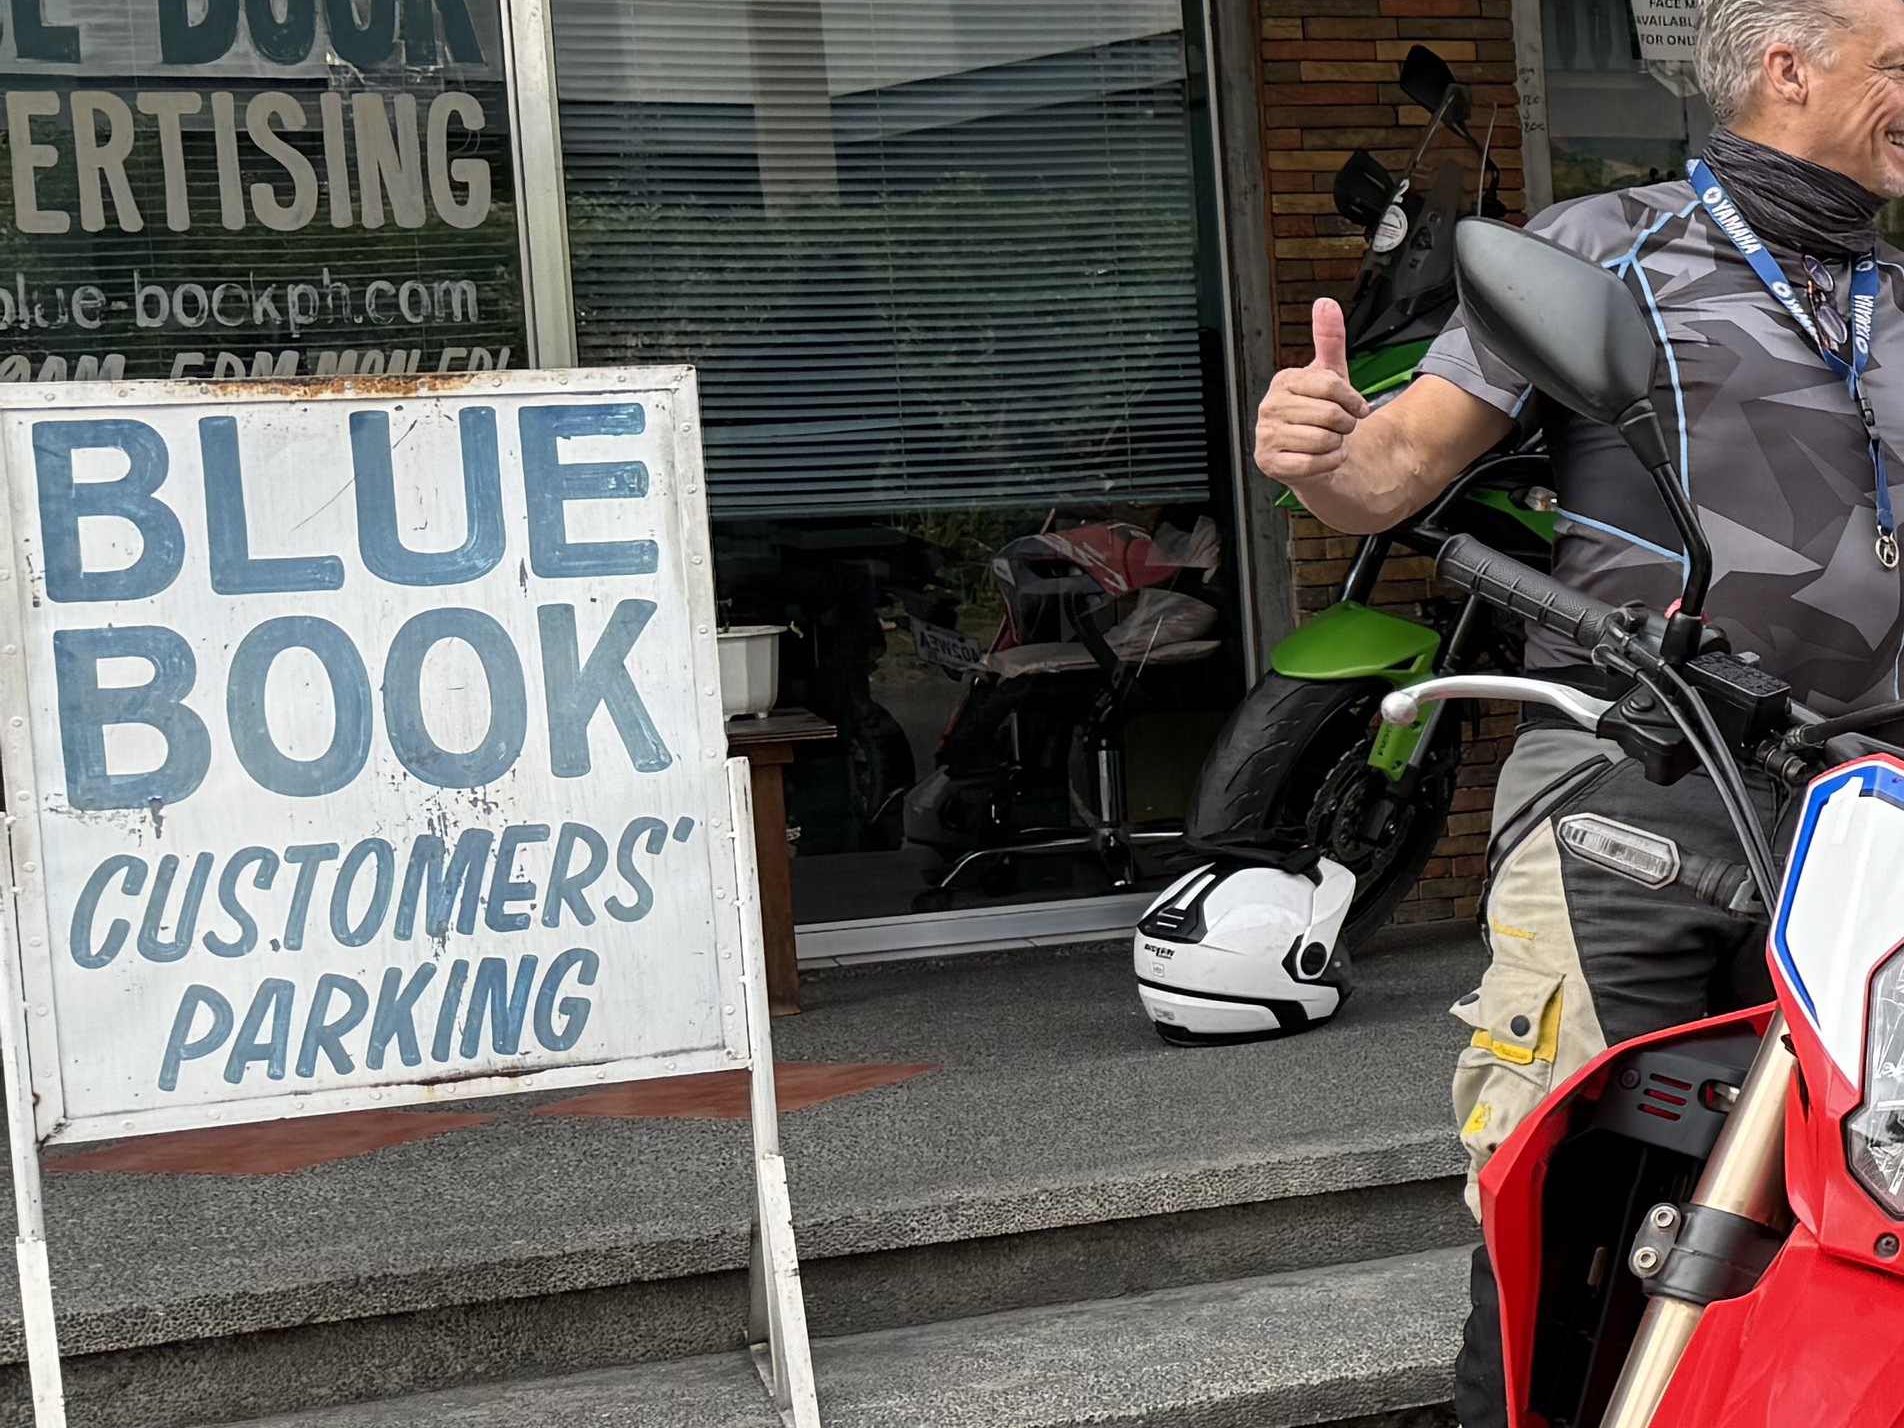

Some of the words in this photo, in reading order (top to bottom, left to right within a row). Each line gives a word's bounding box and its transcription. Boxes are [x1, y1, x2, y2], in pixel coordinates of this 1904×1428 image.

[1636, 15, 1698, 29] AVAILABL
[4, 90, 493, 236] ERTISING
[1711, 198, 1763, 255] YAMAHA
[1853, 294, 1874, 341] YAMAHA
[31, 401, 660, 604] BLUE
[53, 598, 675, 811] BOOK
[69, 815, 697, 970] CUSTOMERS'
[157, 947, 601, 1093] PARKING
